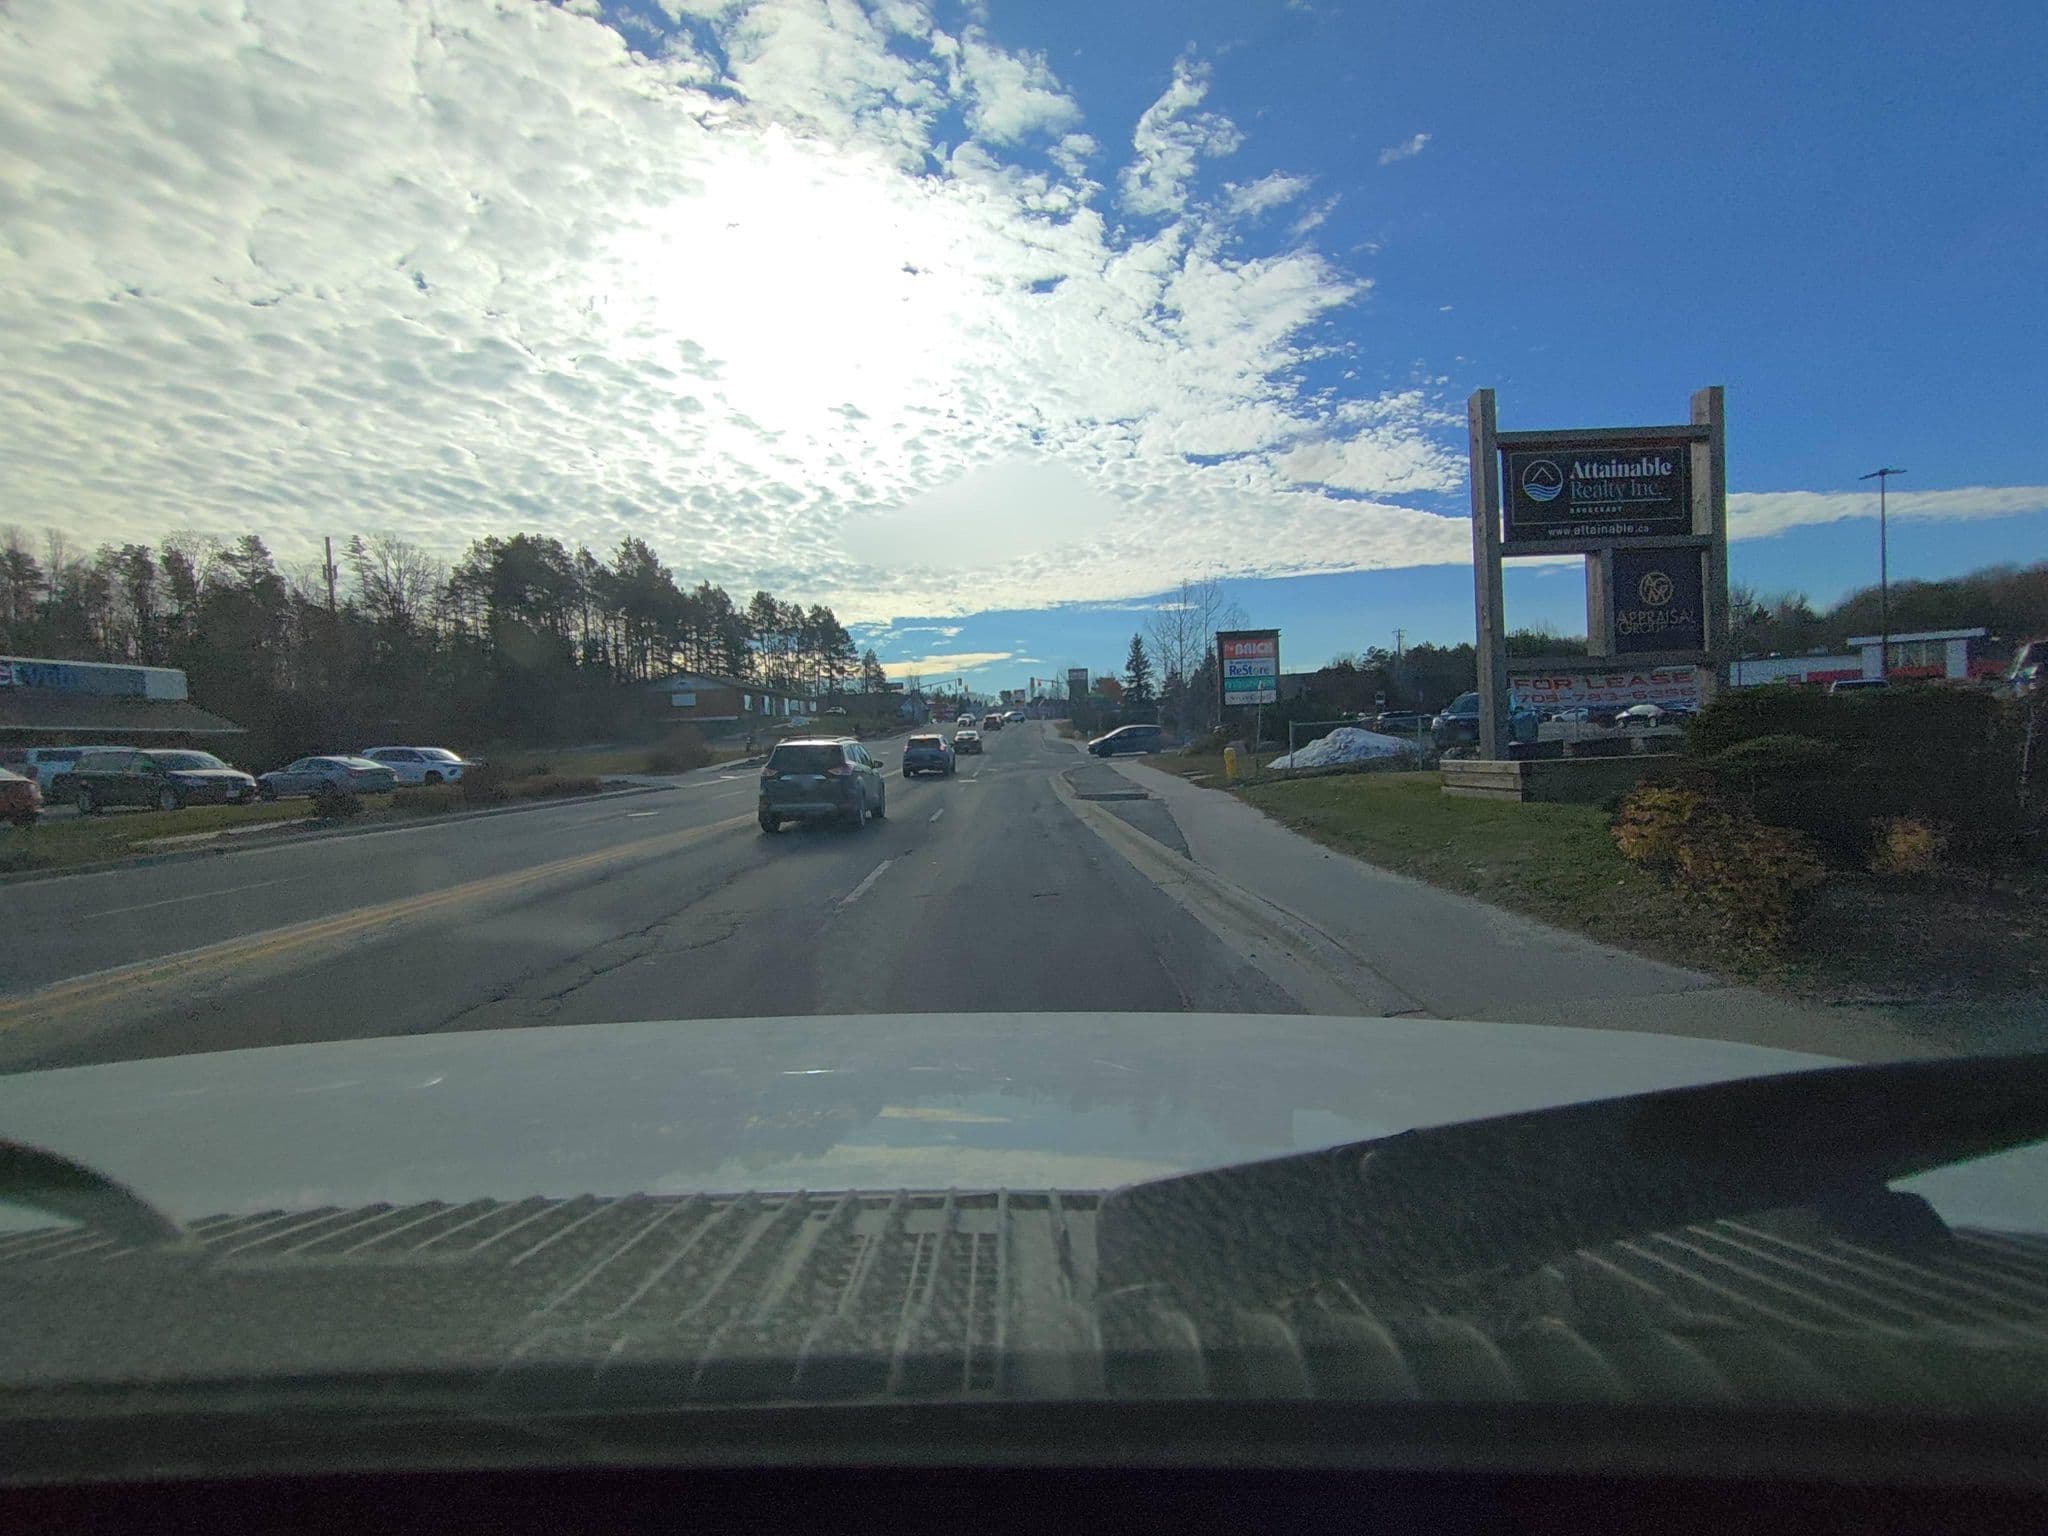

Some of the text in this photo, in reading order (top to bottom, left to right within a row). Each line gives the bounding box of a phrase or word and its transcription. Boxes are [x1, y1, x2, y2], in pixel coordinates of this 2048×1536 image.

[1569, 458, 1673, 479] Attainable
[1570, 478, 1663, 499] Realty Inc.
[1548, 523, 1650, 537] www.attainable.ca
[1514, 673, 1695, 691] FOR LEASE
